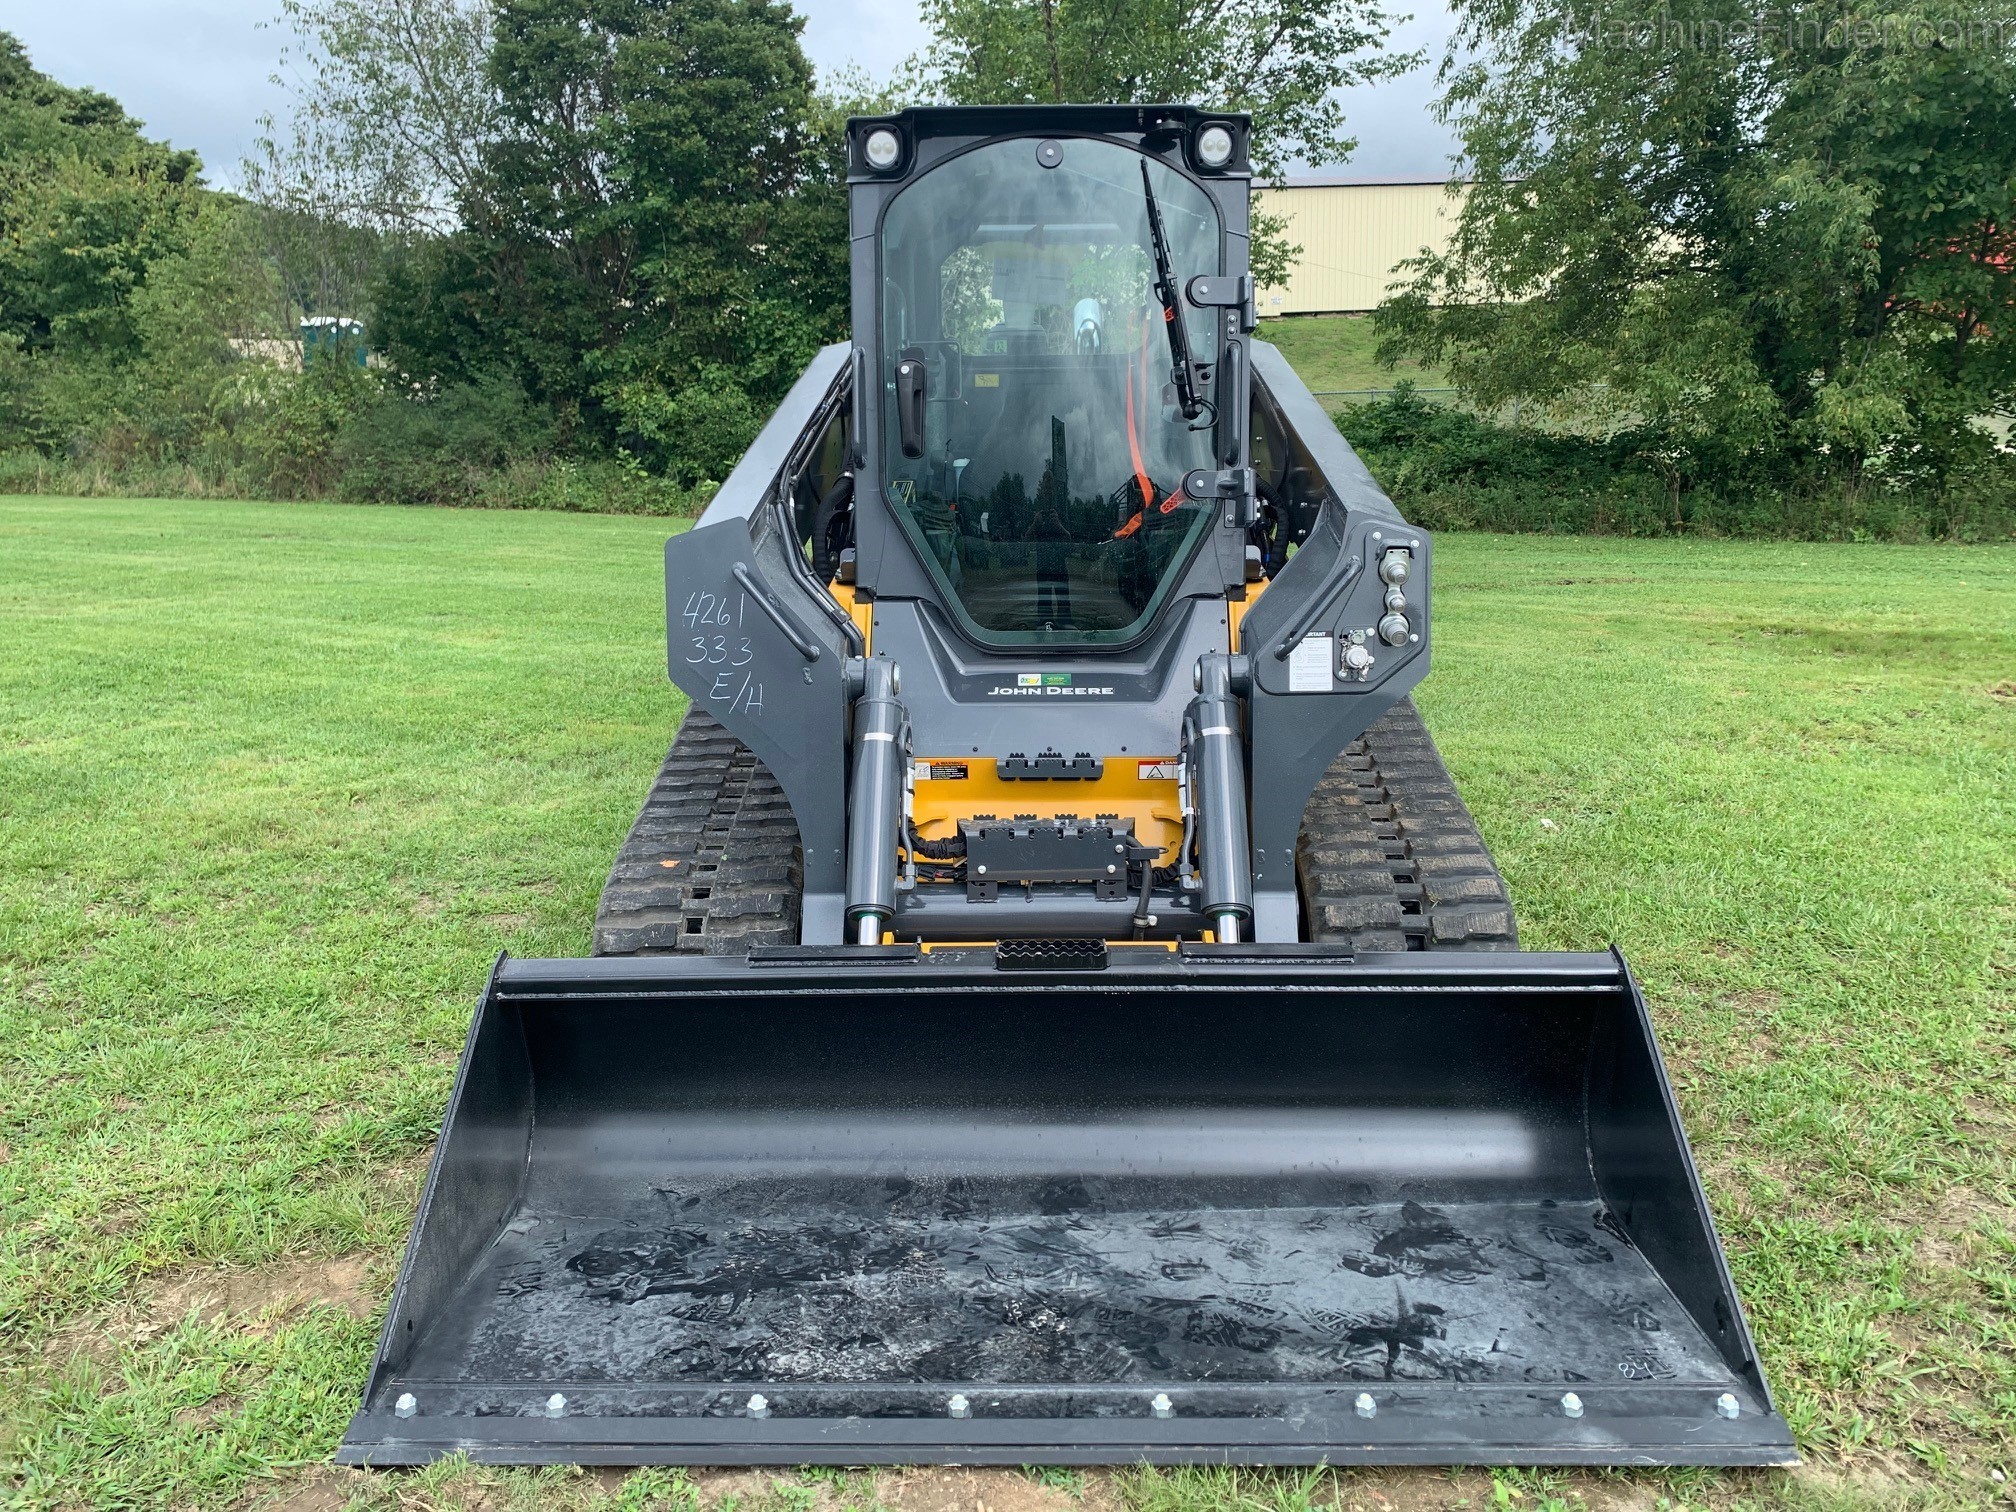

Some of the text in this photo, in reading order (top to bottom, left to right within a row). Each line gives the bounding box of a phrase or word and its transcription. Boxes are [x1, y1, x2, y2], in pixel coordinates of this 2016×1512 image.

[682, 591, 745, 629] 4261
[686, 635, 753, 666] 333
[709, 671, 764, 716] E/H
[987, 687, 1114, 695] JOHN DEERE
[1618, 1362, 1658, 1380] 84
